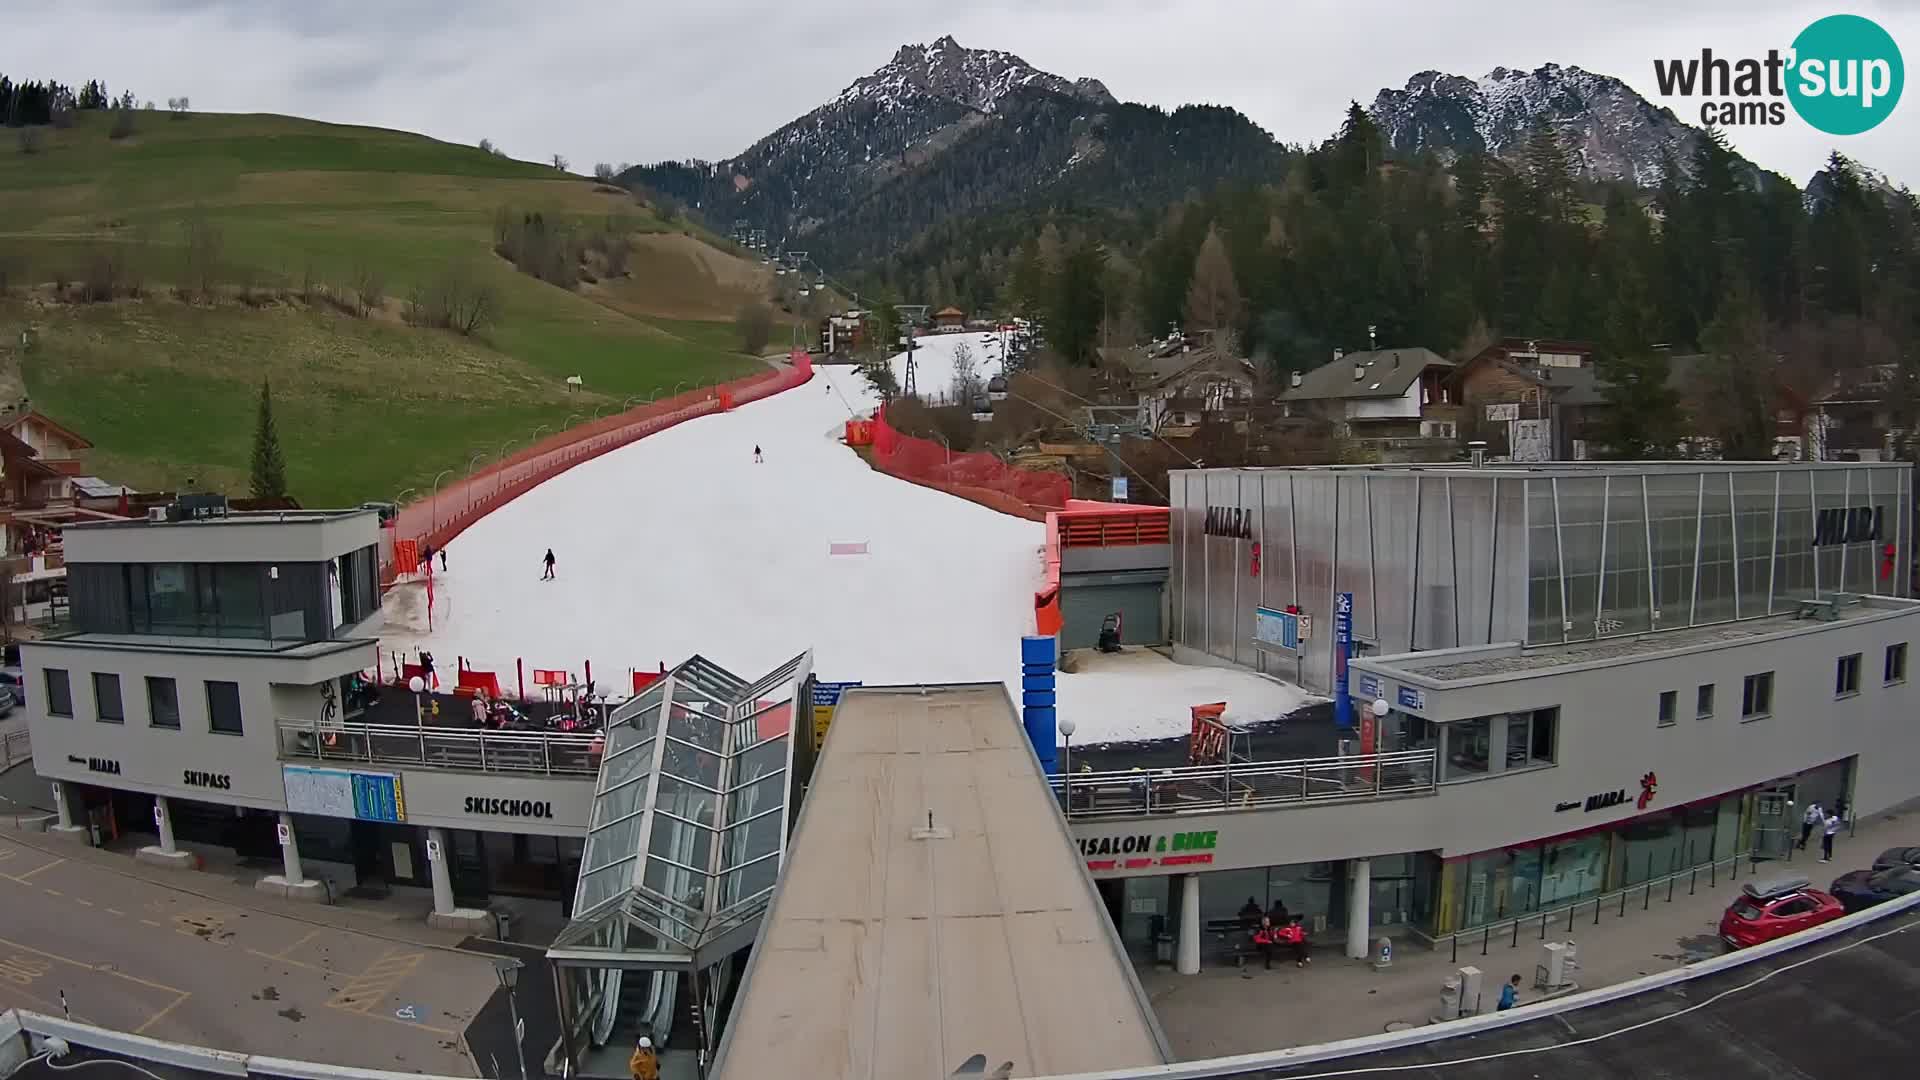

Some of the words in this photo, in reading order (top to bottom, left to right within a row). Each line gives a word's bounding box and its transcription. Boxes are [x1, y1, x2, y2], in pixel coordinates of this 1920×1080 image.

[1204, 506, 1251, 539] MIARA
[88, 757, 121, 775] MIARA
[184, 770, 231, 790] SKIPASS
[464, 796, 553, 818] SKISCHOOL
[1584, 789, 1625, 813] MIARA
[1076, 834, 1152, 856] ISALON
[1172, 830, 1218, 851] BIKE
